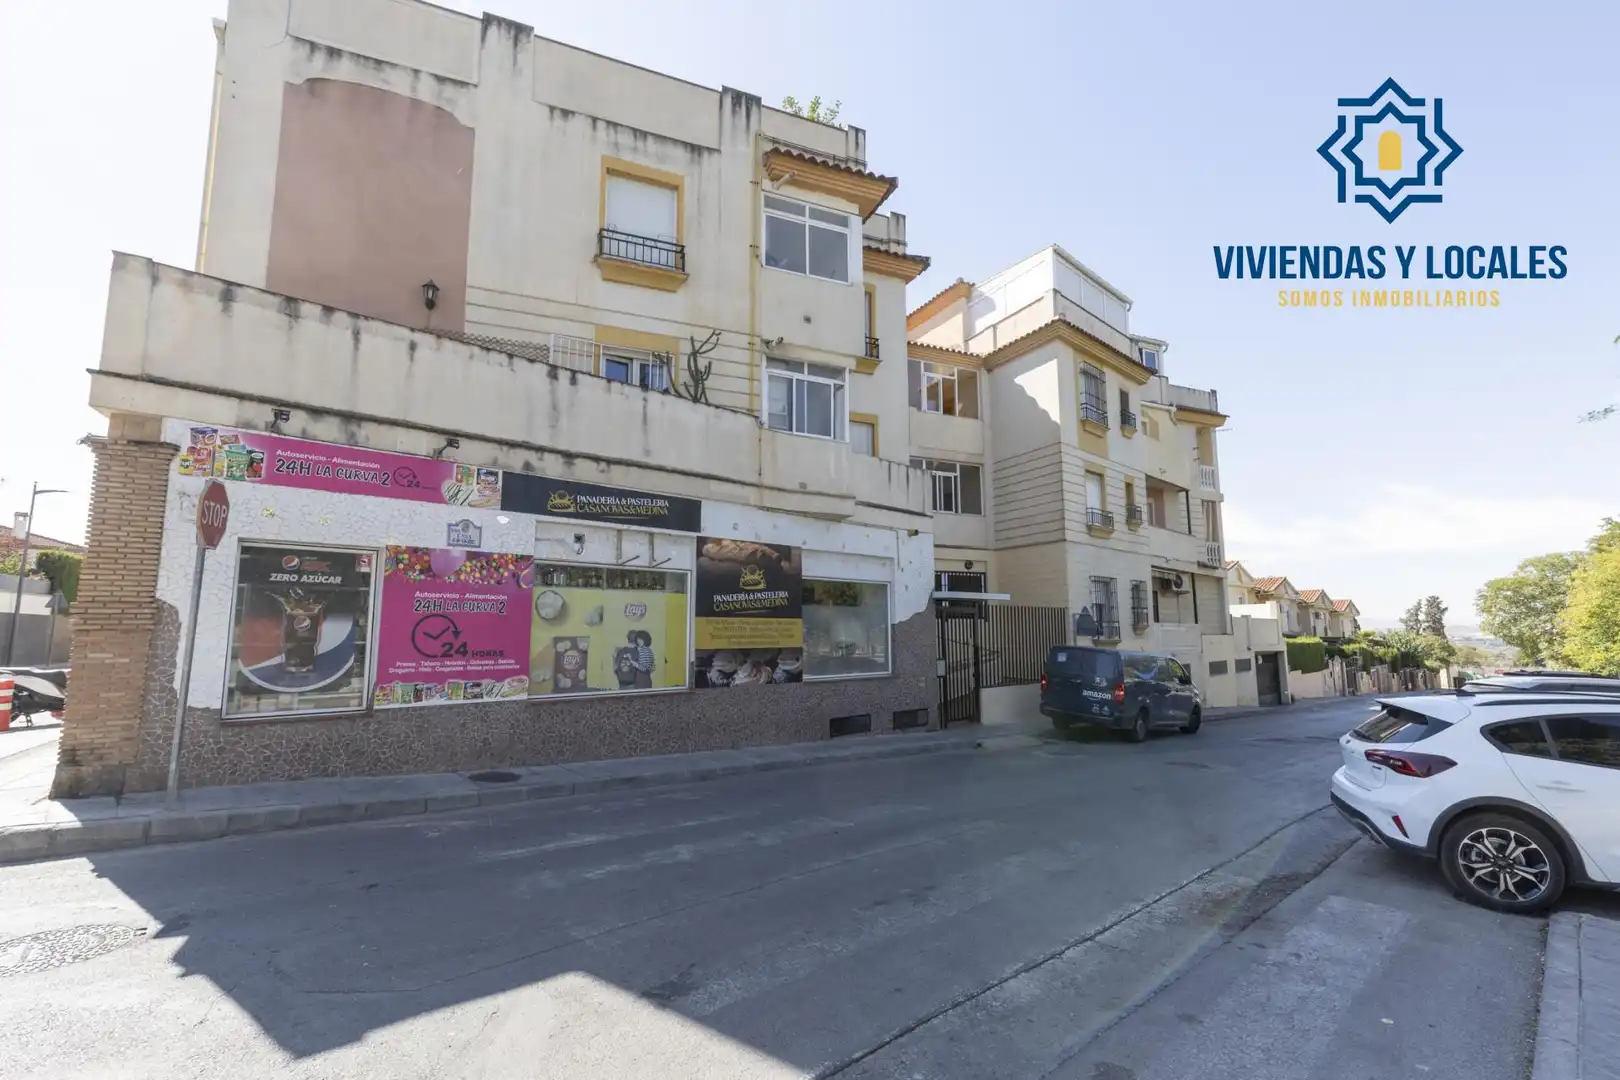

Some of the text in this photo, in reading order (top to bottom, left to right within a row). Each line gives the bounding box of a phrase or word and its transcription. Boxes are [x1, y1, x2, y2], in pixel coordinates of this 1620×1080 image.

[276, 449, 327, 462] Autoservicio
[332, 457, 380, 469] Alimentación
[274, 458, 312, 476] 24H
[316, 464, 332, 478] LA
[336, 467, 380, 485] CURVA
[406, 480, 420, 489] 24
[202, 500, 228, 528] STOP
[269, 573, 342, 584] ZERO AZÚCAR
[414, 590, 459, 599] Autoservicio
[464, 592, 508, 600] Alimentación
[413, 598, 507, 615] 24H LA CURVA 2
[440, 641, 468, 658] 24
[1082, 689, 1112, 701] amazon
